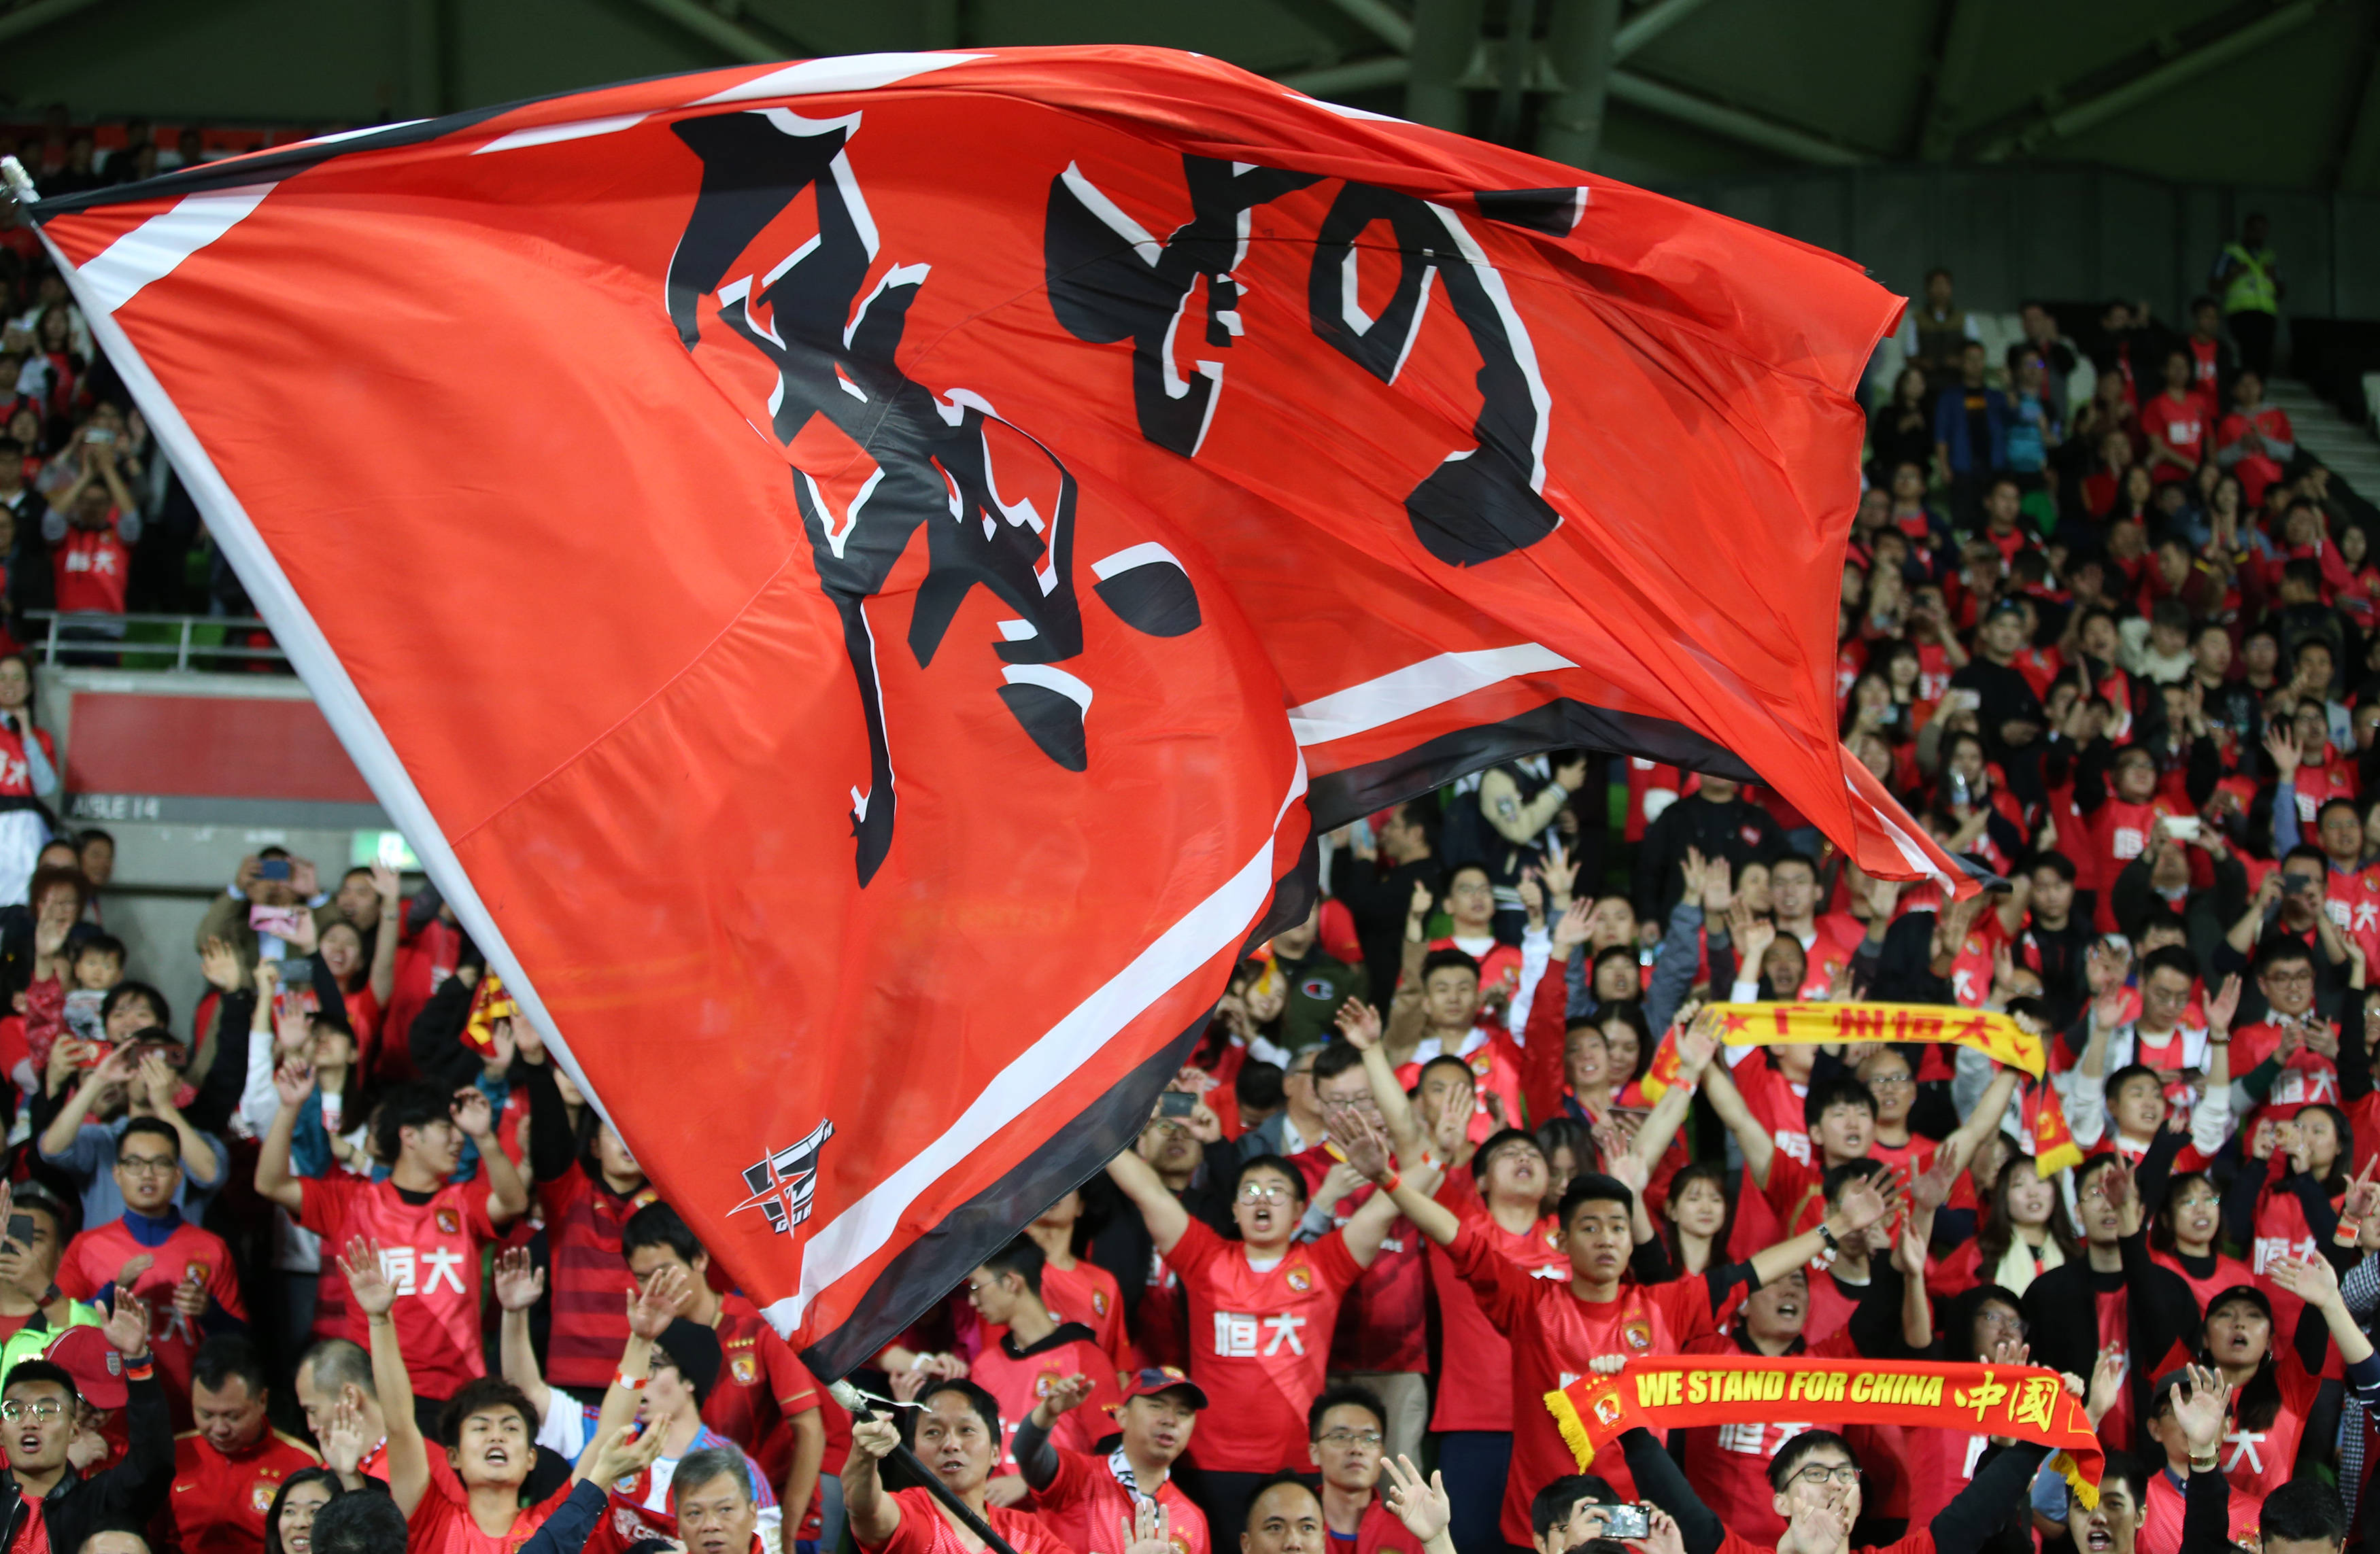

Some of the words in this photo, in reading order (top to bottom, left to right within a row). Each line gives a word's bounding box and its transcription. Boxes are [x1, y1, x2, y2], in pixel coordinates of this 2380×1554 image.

[73, 794, 126, 819] AISLE
[133, 796, 159, 820] 14
[1773, 1006, 2002, 1048] 广州恒大
[1213, 1311, 1307, 1358] 恒大
[1635, 1371, 1683, 1409] WE
[1687, 1370, 1786, 1405] STAND
[1788, 1371, 1848, 1403] FOR
[1850, 1372, 1945, 1406] CHINA
[1954, 1370, 2060, 1433] 中國
